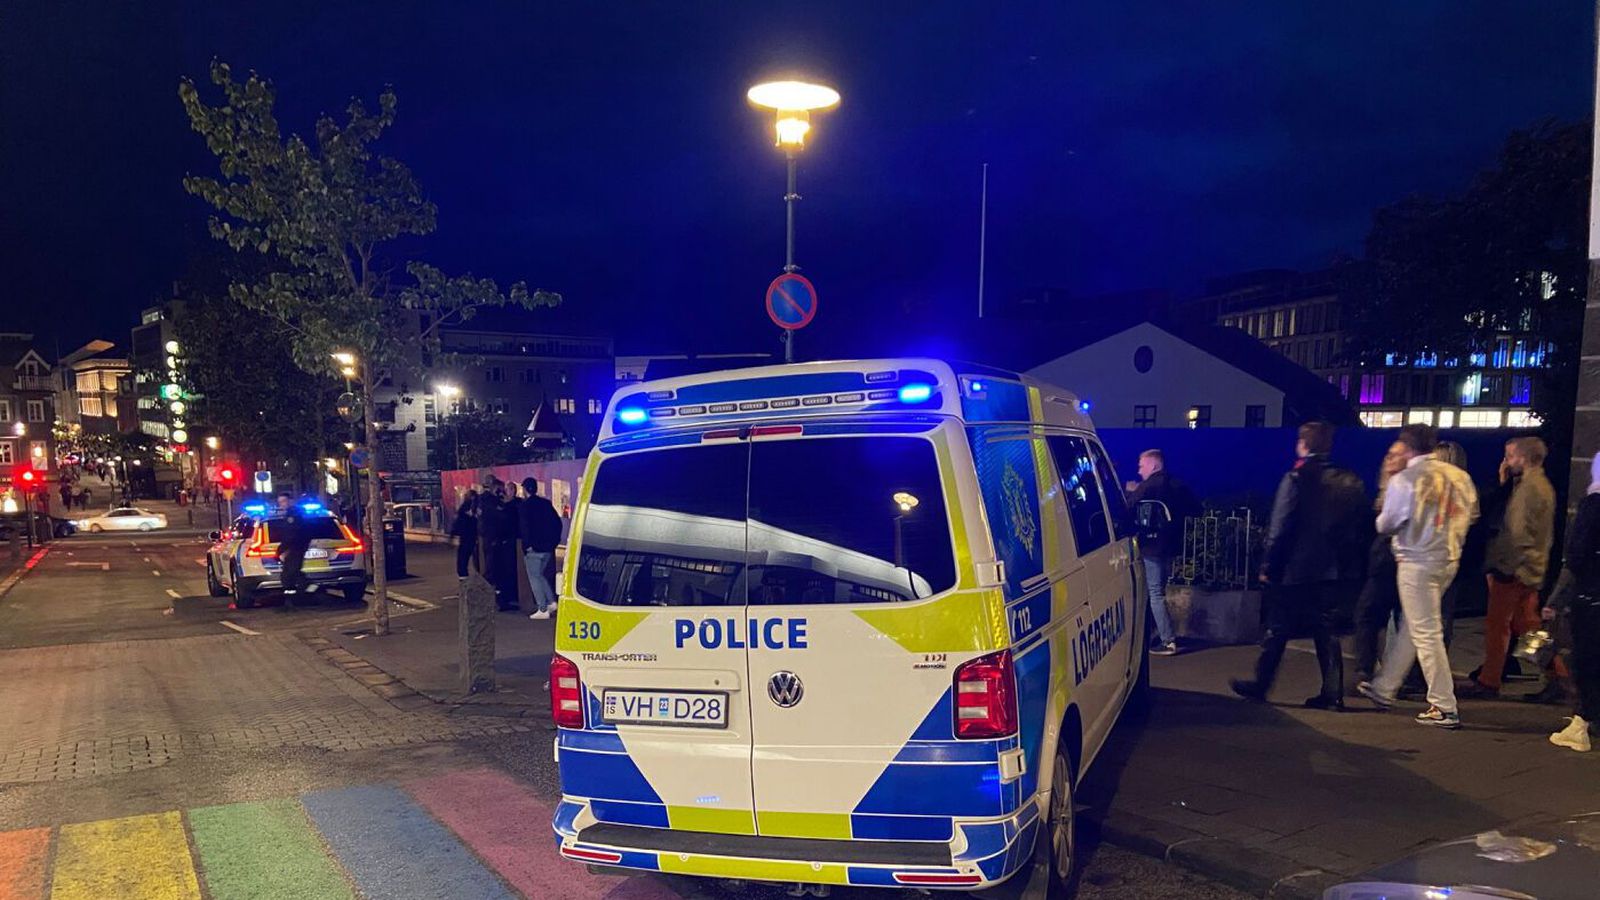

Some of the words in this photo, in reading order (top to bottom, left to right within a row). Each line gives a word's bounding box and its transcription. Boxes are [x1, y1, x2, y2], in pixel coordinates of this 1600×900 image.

[568, 621, 601, 640] 130
[1018, 606, 1032, 633] 112
[676, 618, 808, 649] POLICE
[1072, 596, 1125, 686] LÖGREGLAN
[582, 653, 657, 661] TRANSPORTER
[606, 706, 616, 714] IS
[621, 695, 653, 718] VH
[674, 698, 721, 720] D28
